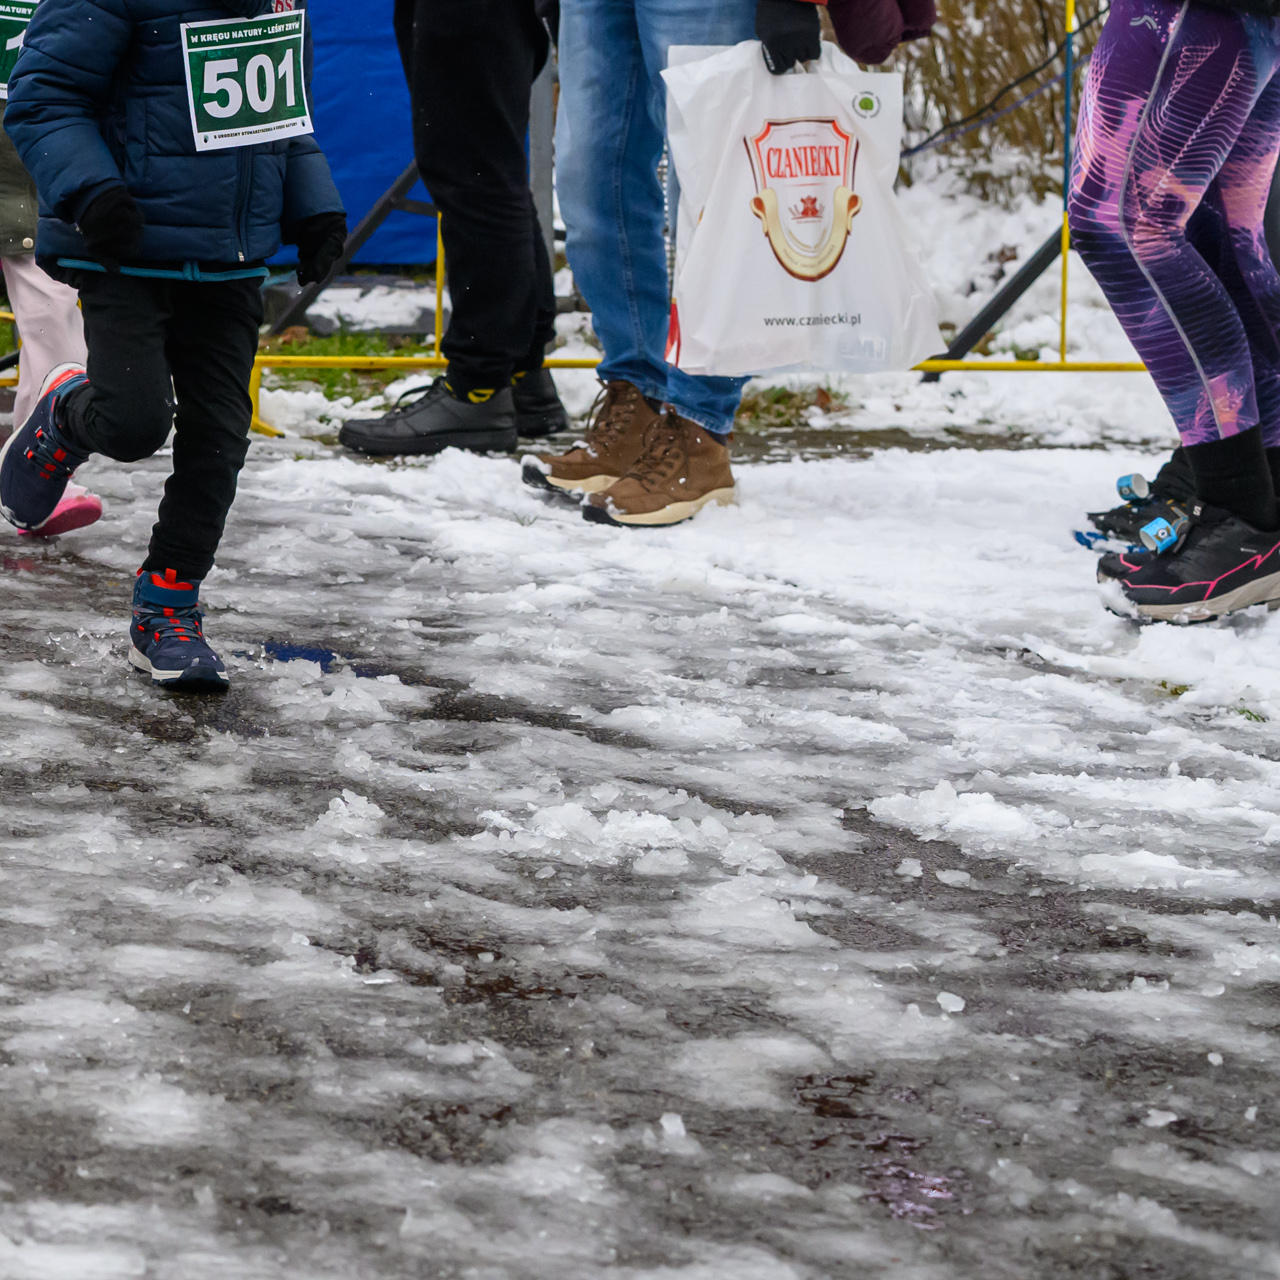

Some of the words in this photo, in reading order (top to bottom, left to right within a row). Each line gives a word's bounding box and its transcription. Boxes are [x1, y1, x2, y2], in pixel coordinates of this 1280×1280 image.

[0, 5, 32, 15] NATURY
[190, 35, 199, 43] W
[200, 33, 230, 43] KRĘGU
[232, 28, 262, 39] NATURY
[268, 23, 284, 34] LEŚNY
[285, 21, 299, 31] ZRYW
[203, 48, 296, 118] 501
[766, 145, 841, 178] CZANIECKI
